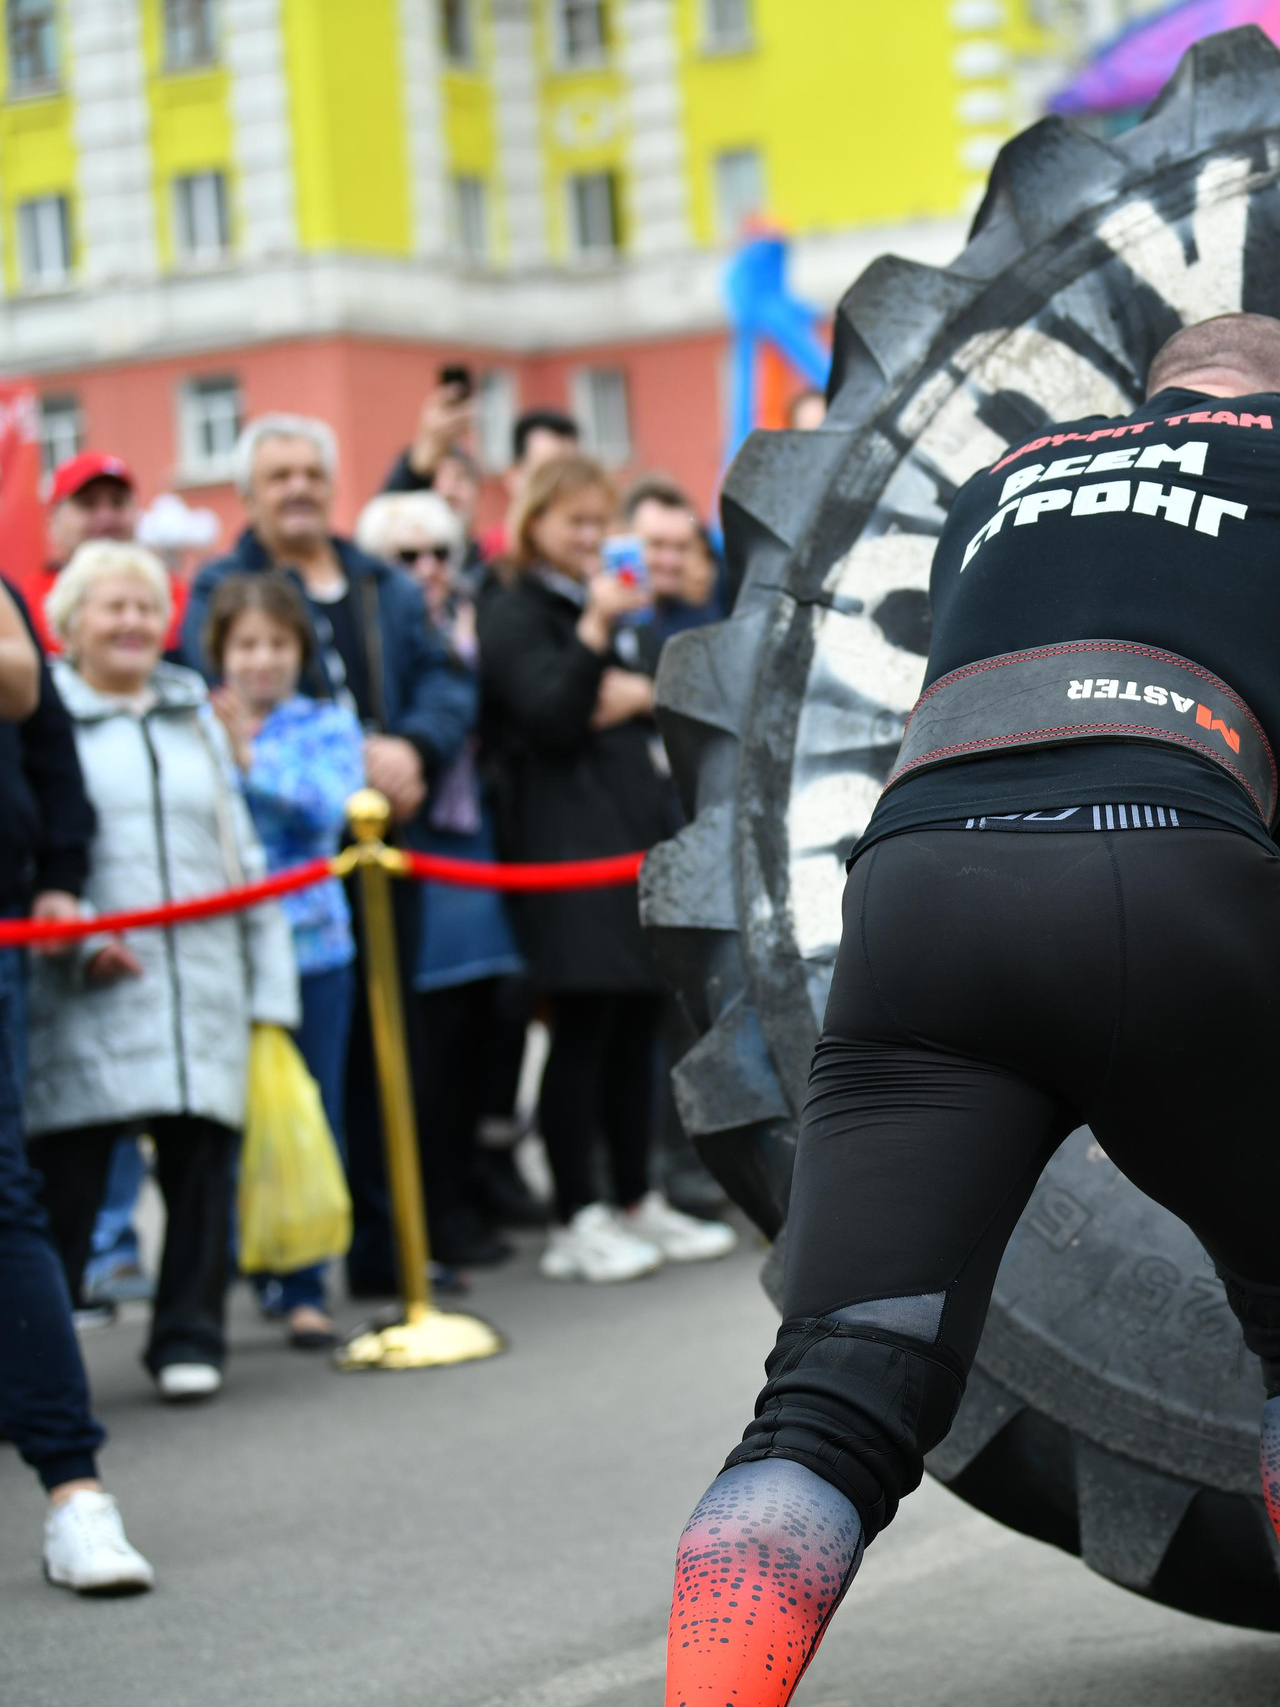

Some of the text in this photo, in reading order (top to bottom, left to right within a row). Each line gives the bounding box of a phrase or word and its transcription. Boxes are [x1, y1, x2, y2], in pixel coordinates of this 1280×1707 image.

[1164, 411, 1273, 429] TEAM
[998, 441, 1209, 507] ВСЕМ
[960, 480, 1248, 574] СТРОНГ
[1067, 678, 1240, 754] MASTER
